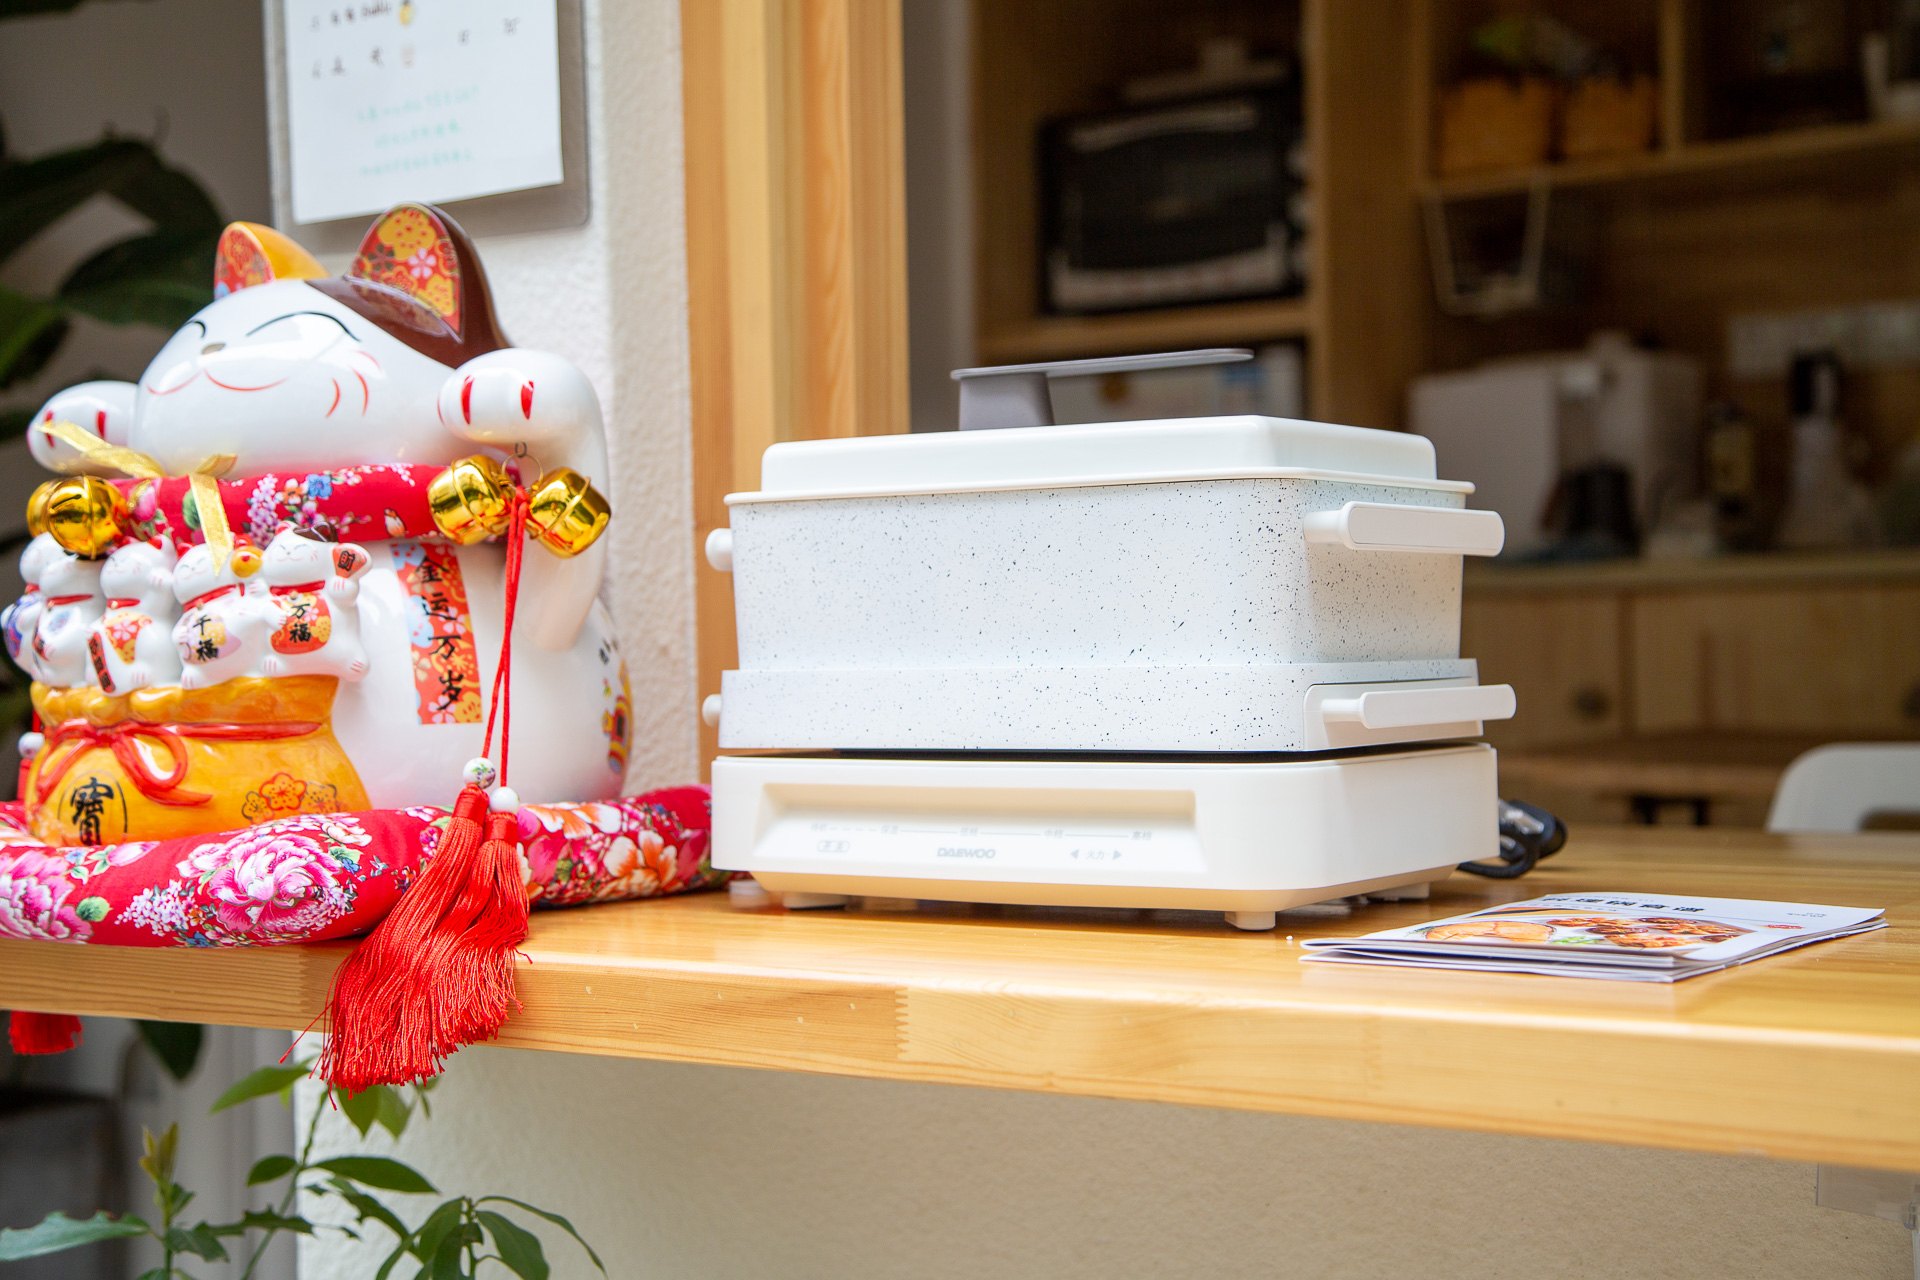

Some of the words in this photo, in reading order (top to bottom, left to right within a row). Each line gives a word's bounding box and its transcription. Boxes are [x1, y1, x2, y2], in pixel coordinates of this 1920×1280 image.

[288, 602, 313, 644] 万福
[415, 555, 466, 712] 金运万岁
[193, 614, 220, 662] 千福
[1044, 827, 1063, 839] 中档
[1131, 830, 1152, 841] 高档
[936, 847, 996, 859] DAEWOO
[1085, 847, 1106, 860] 火力
